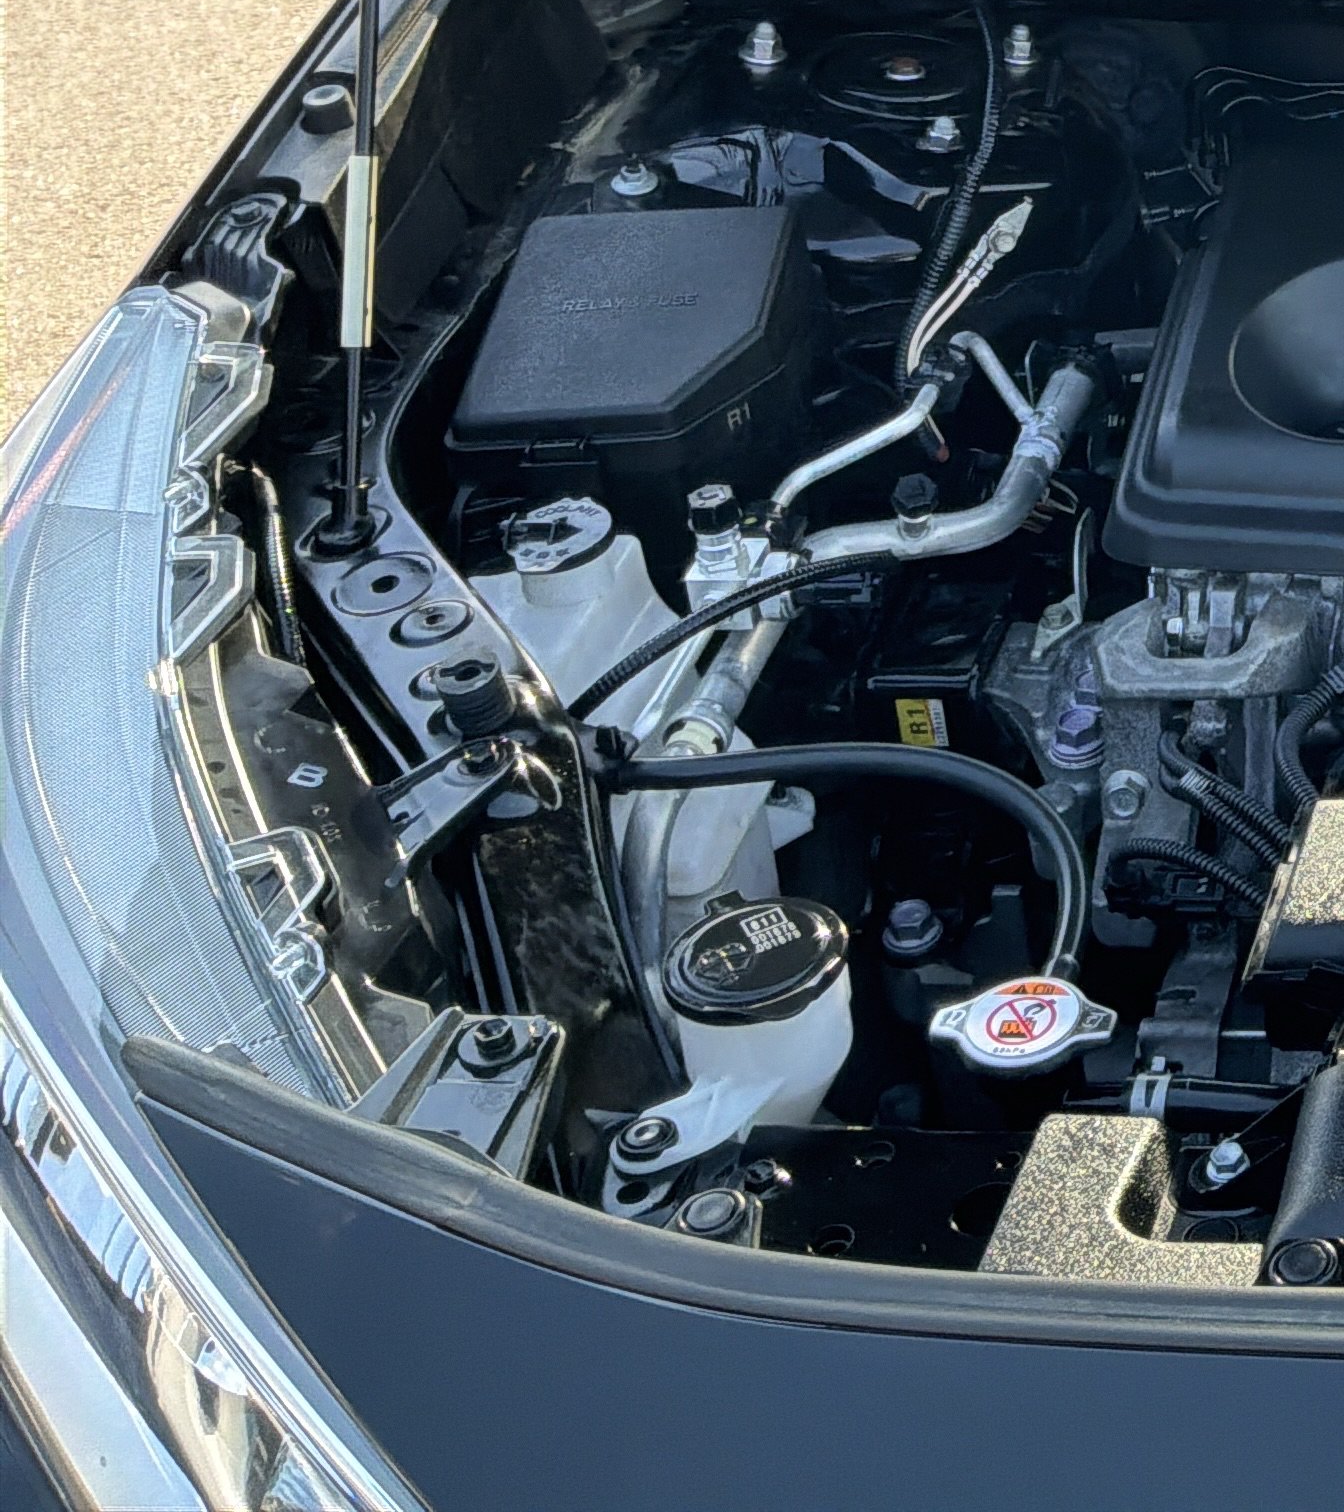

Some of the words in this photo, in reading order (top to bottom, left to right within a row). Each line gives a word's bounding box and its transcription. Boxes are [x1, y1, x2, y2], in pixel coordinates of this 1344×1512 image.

[561, 297, 626, 313] RELAY
[647, 292, 700, 308] FUSE
[906, 709, 929, 735] R1
